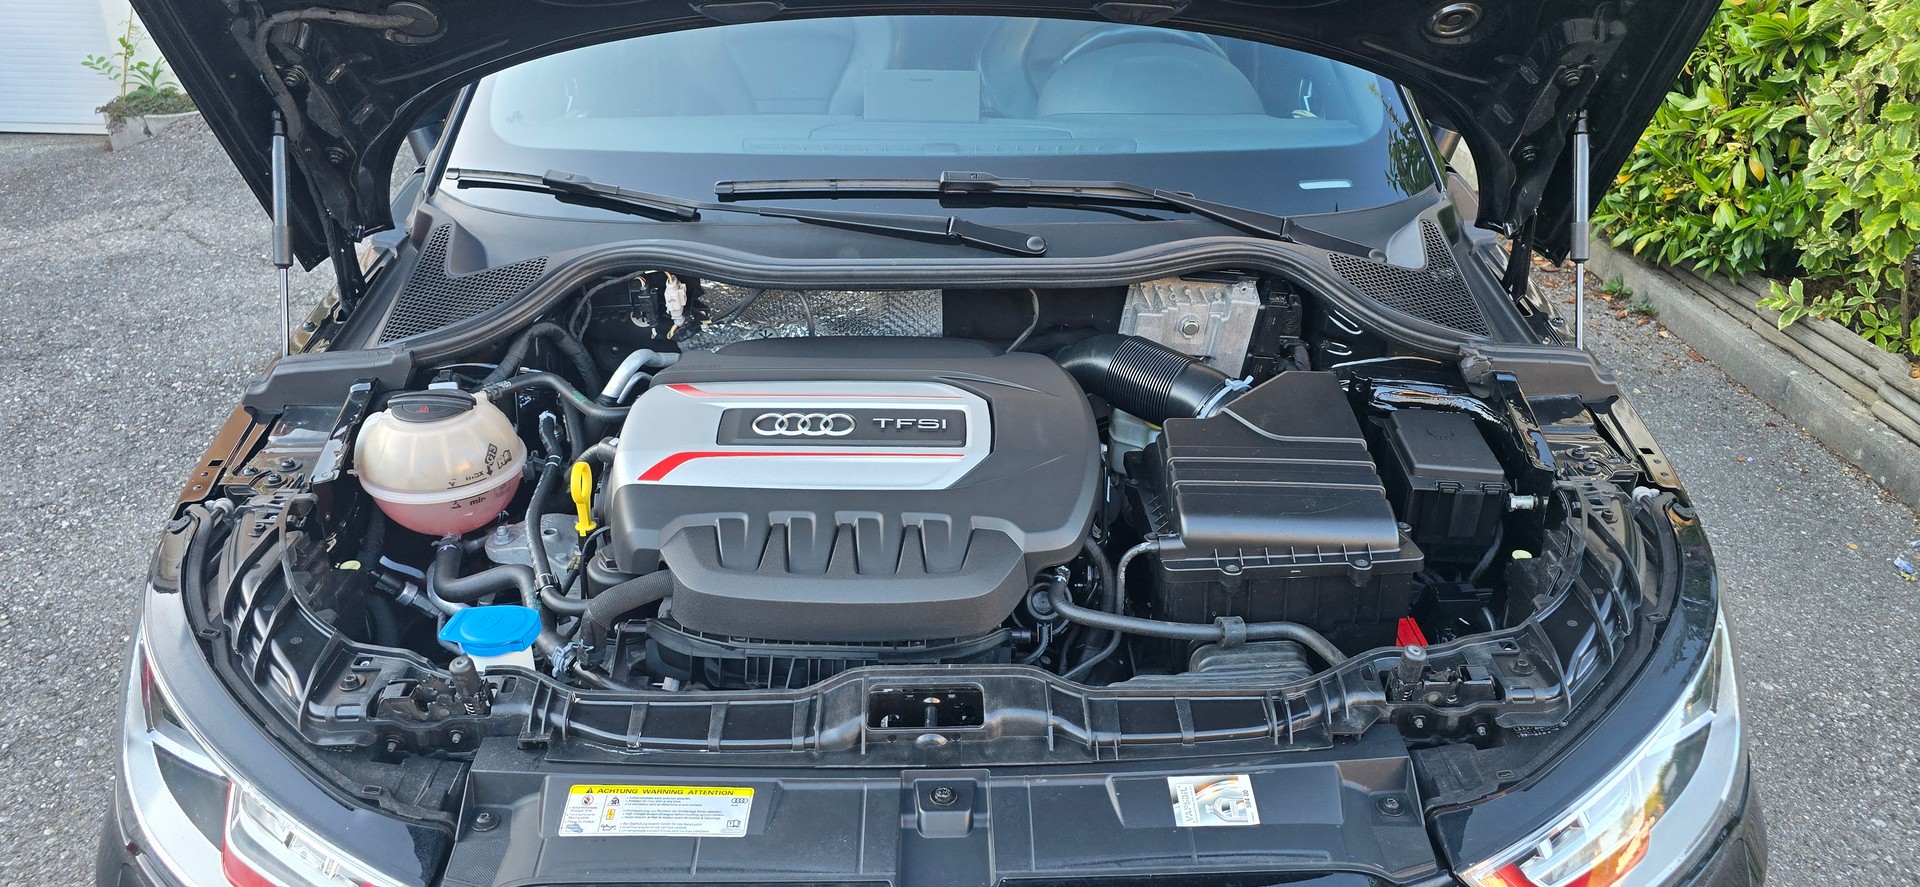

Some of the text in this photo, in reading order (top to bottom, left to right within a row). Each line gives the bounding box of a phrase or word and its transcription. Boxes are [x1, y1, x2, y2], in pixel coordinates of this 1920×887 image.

[872, 418, 947, 431] TFSI
[469, 496, 486, 506] min
[1242, 789, 1249, 797] 00
